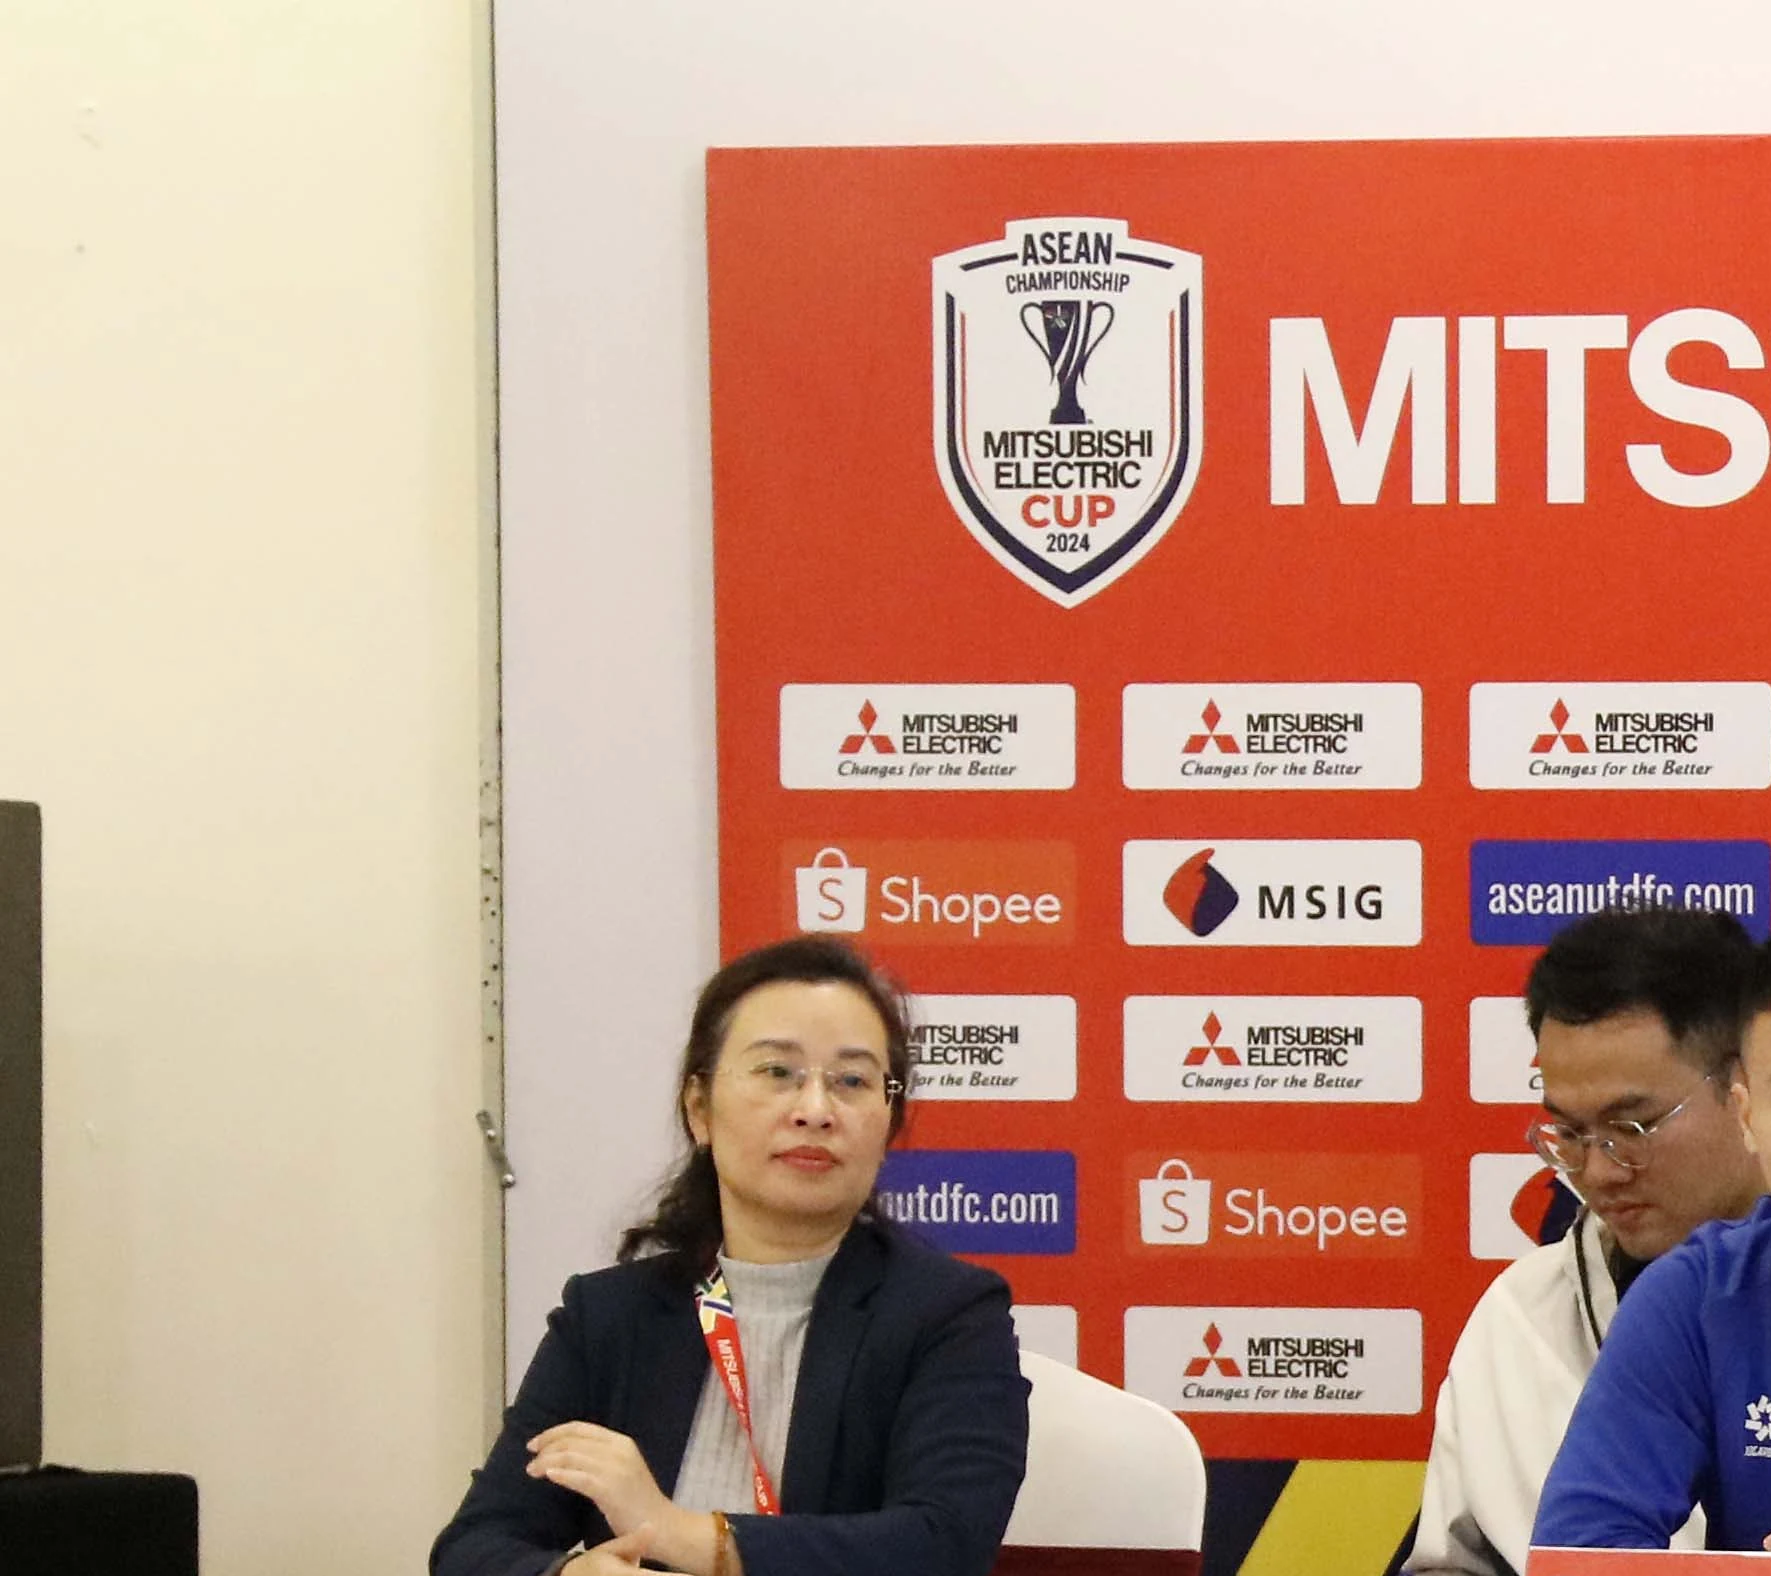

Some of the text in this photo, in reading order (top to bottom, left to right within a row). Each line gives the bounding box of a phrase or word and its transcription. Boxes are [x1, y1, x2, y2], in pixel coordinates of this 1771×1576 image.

[1022, 232, 1112, 267] ASEAN
[1006, 273, 1129, 294] CHAMPIONSHIP
[984, 430, 1152, 459] MITSUBISHI
[995, 461, 1141, 489] ELECTRIC
[1022, 495, 1115, 528] CUP
[1046, 533, 1091, 553] 2024
[903, 714, 1017, 733] MITSUBISHI
[1596, 713, 1713, 732] MITSUBISHI
[903, 735, 1001, 754] ELECTRIC
[1596, 734, 1697, 753] ELECTRIC
[838, 760, 1016, 778] Changes for the Better
[1529, 760, 1713, 778] Changes for the Better
[1259, 885, 1381, 920] MSIG
[1489, 873, 1753, 914] aseanutdfccom
[881, 876, 1061, 937] Shopee
[1248, 1026, 1363, 1045] MITSUBISHI
[1248, 1047, 1347, 1066] ELECTRIC
[1182, 1072, 1363, 1090] Changes for the Better
[875, 1181, 1057, 1223] nutdfc.com
[1225, 1189, 1407, 1250] Shopee
